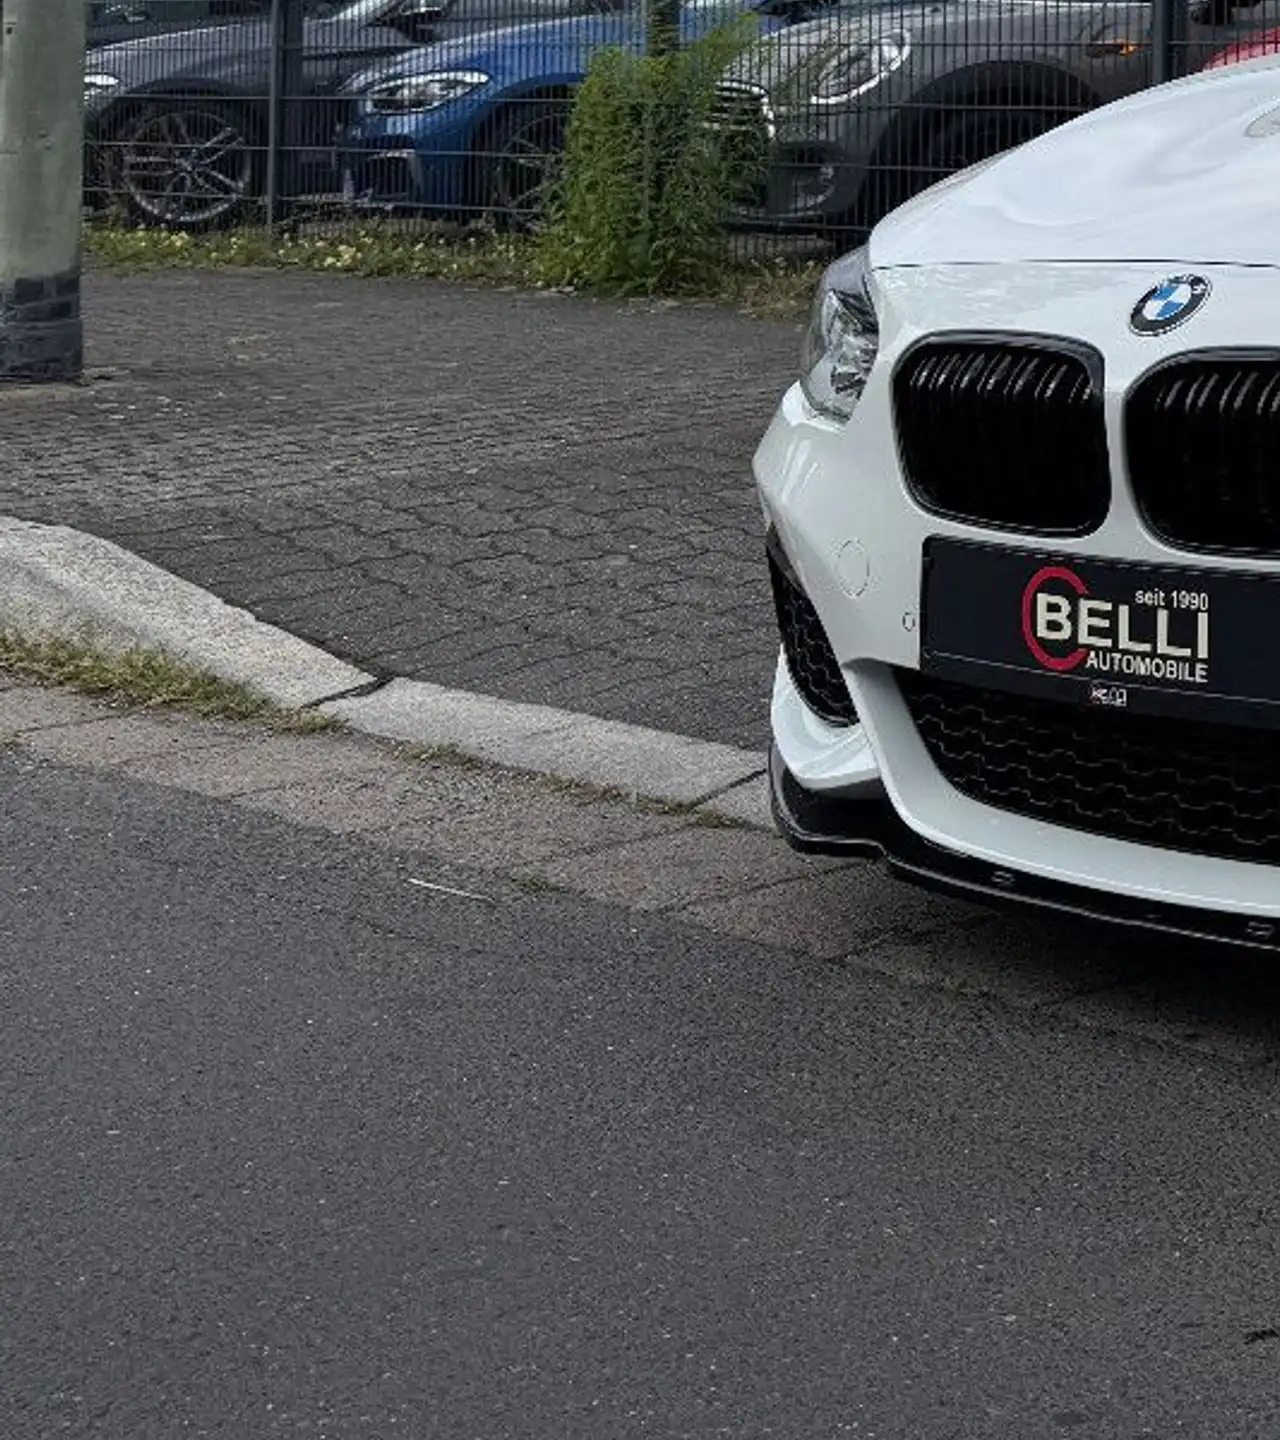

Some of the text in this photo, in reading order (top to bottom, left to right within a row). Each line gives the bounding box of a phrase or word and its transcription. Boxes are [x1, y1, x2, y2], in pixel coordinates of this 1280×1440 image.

[1135, 588, 1209, 611] seit 1990
[1035, 591, 1209, 659] BELLI
[1086, 650, 1209, 683] AUTOMOBILE
